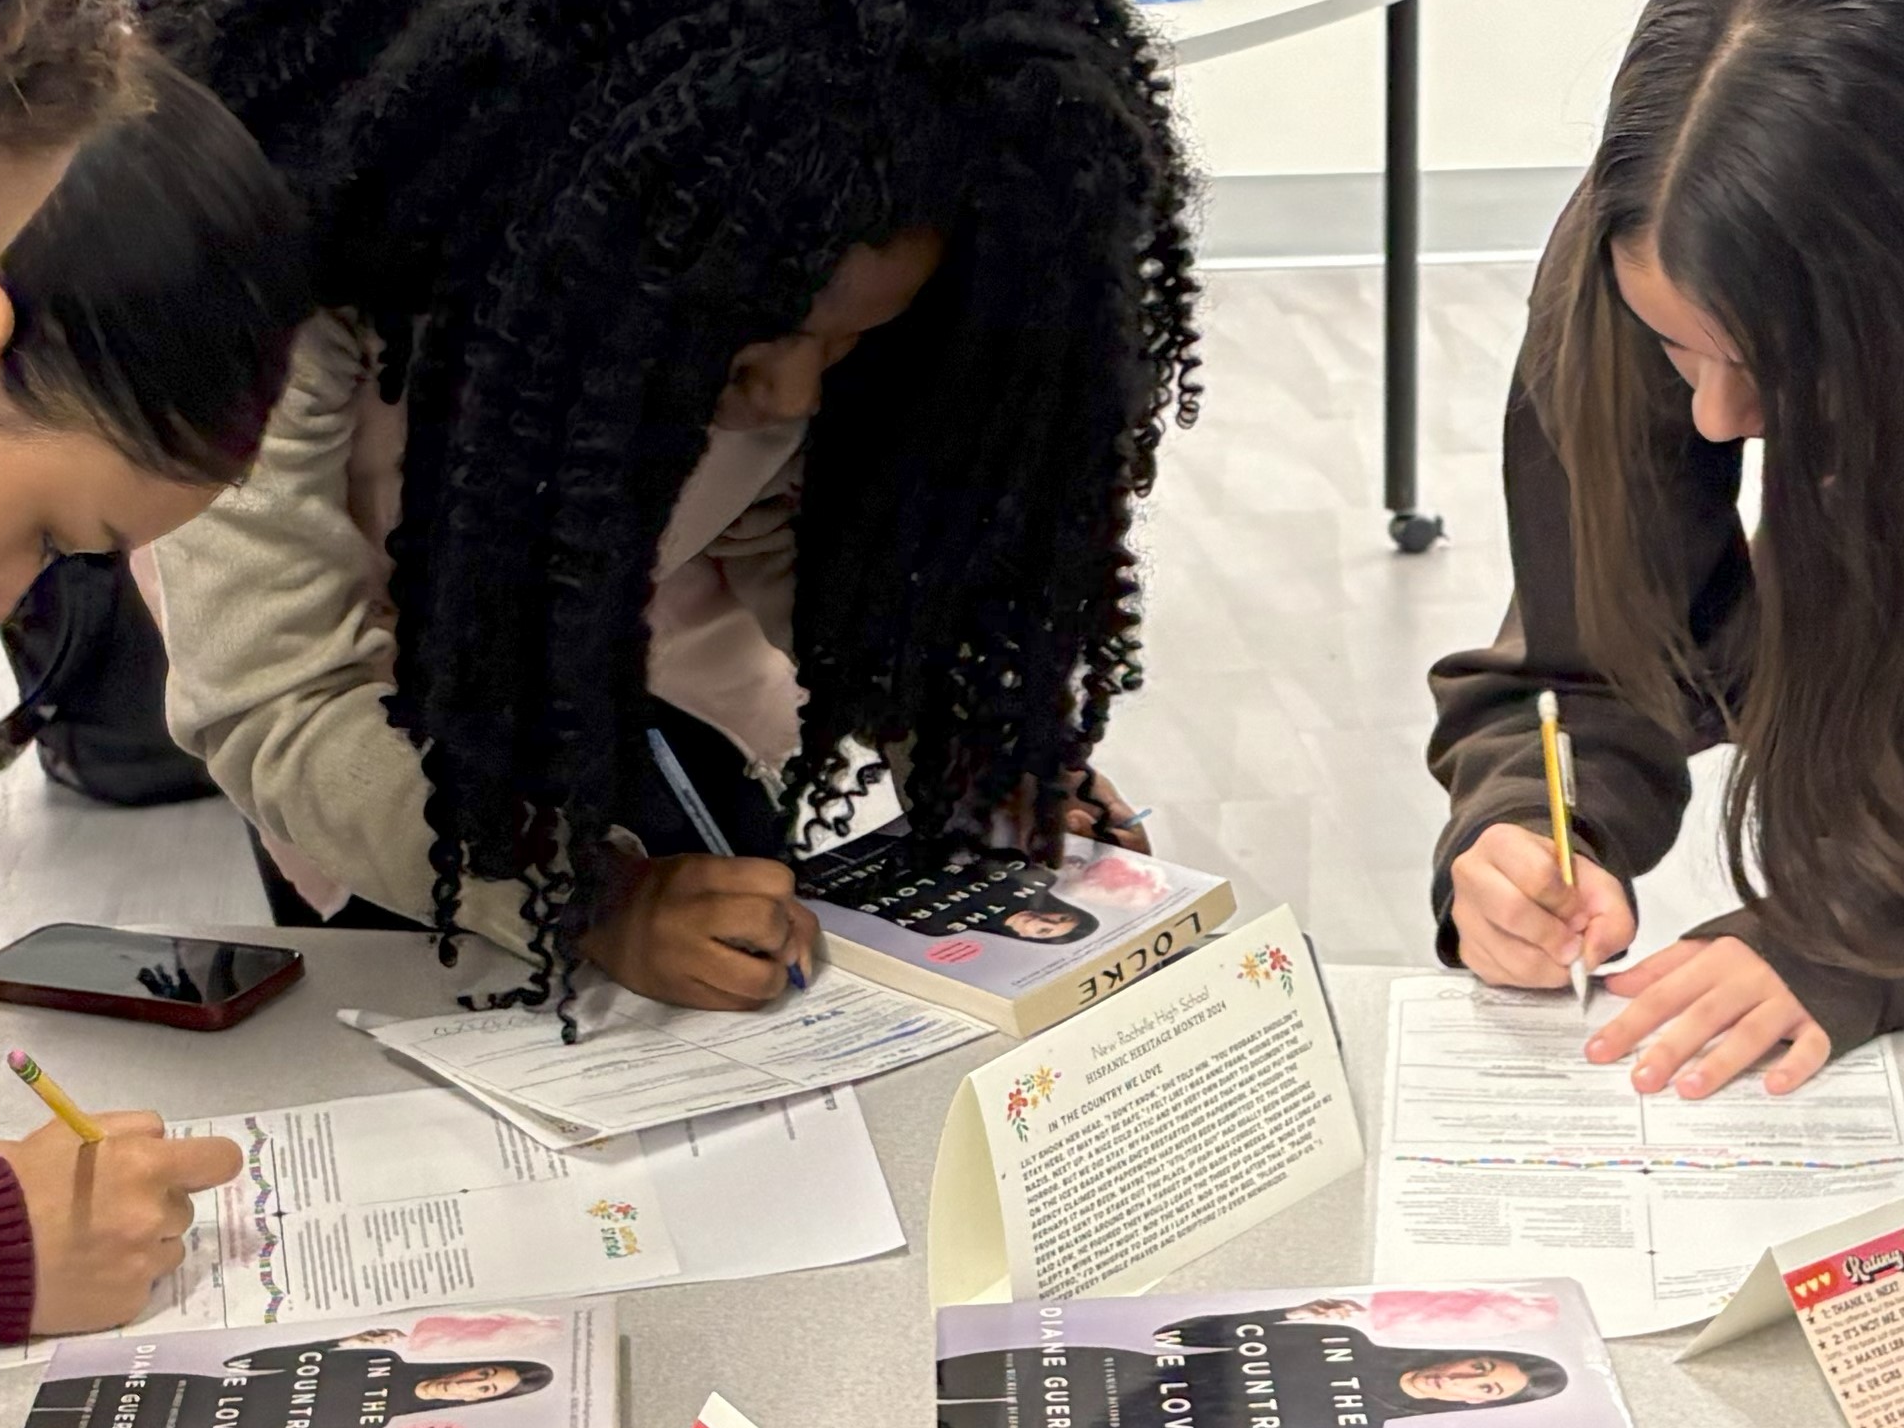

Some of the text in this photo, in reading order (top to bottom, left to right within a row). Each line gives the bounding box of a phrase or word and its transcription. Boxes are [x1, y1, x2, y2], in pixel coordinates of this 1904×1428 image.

[858, 877, 937, 915] LOVE
[896, 858, 1028, 930] COUNTRY
[946, 880, 1046, 934] IN THE
[1077, 910, 1202, 1007] LOCKE
[1085, 1000, 1226, 1084] HISPANIC HERITAGE MONTH 2024
[1090, 985, 1209, 1060] New Rochelle High School
[1048, 1063, 1162, 1132] IN THE COUNTRY WE LOVE
[1830, 1280, 1899, 1315] THANK NEXT
[1859, 1317, 1880, 1332] NOT
[1036, 1306, 1068, 1367] DIANE
[1150, 1330, 1186, 1367] WE
[1854, 1343, 1888, 1364] MAYBE
[122, 1344, 156, 1389] DIANE
[220, 1358, 252, 1387] WE
[358, 1357, 391, 1425] IN THE
[1321, 1336, 1367, 1425] IN THE
